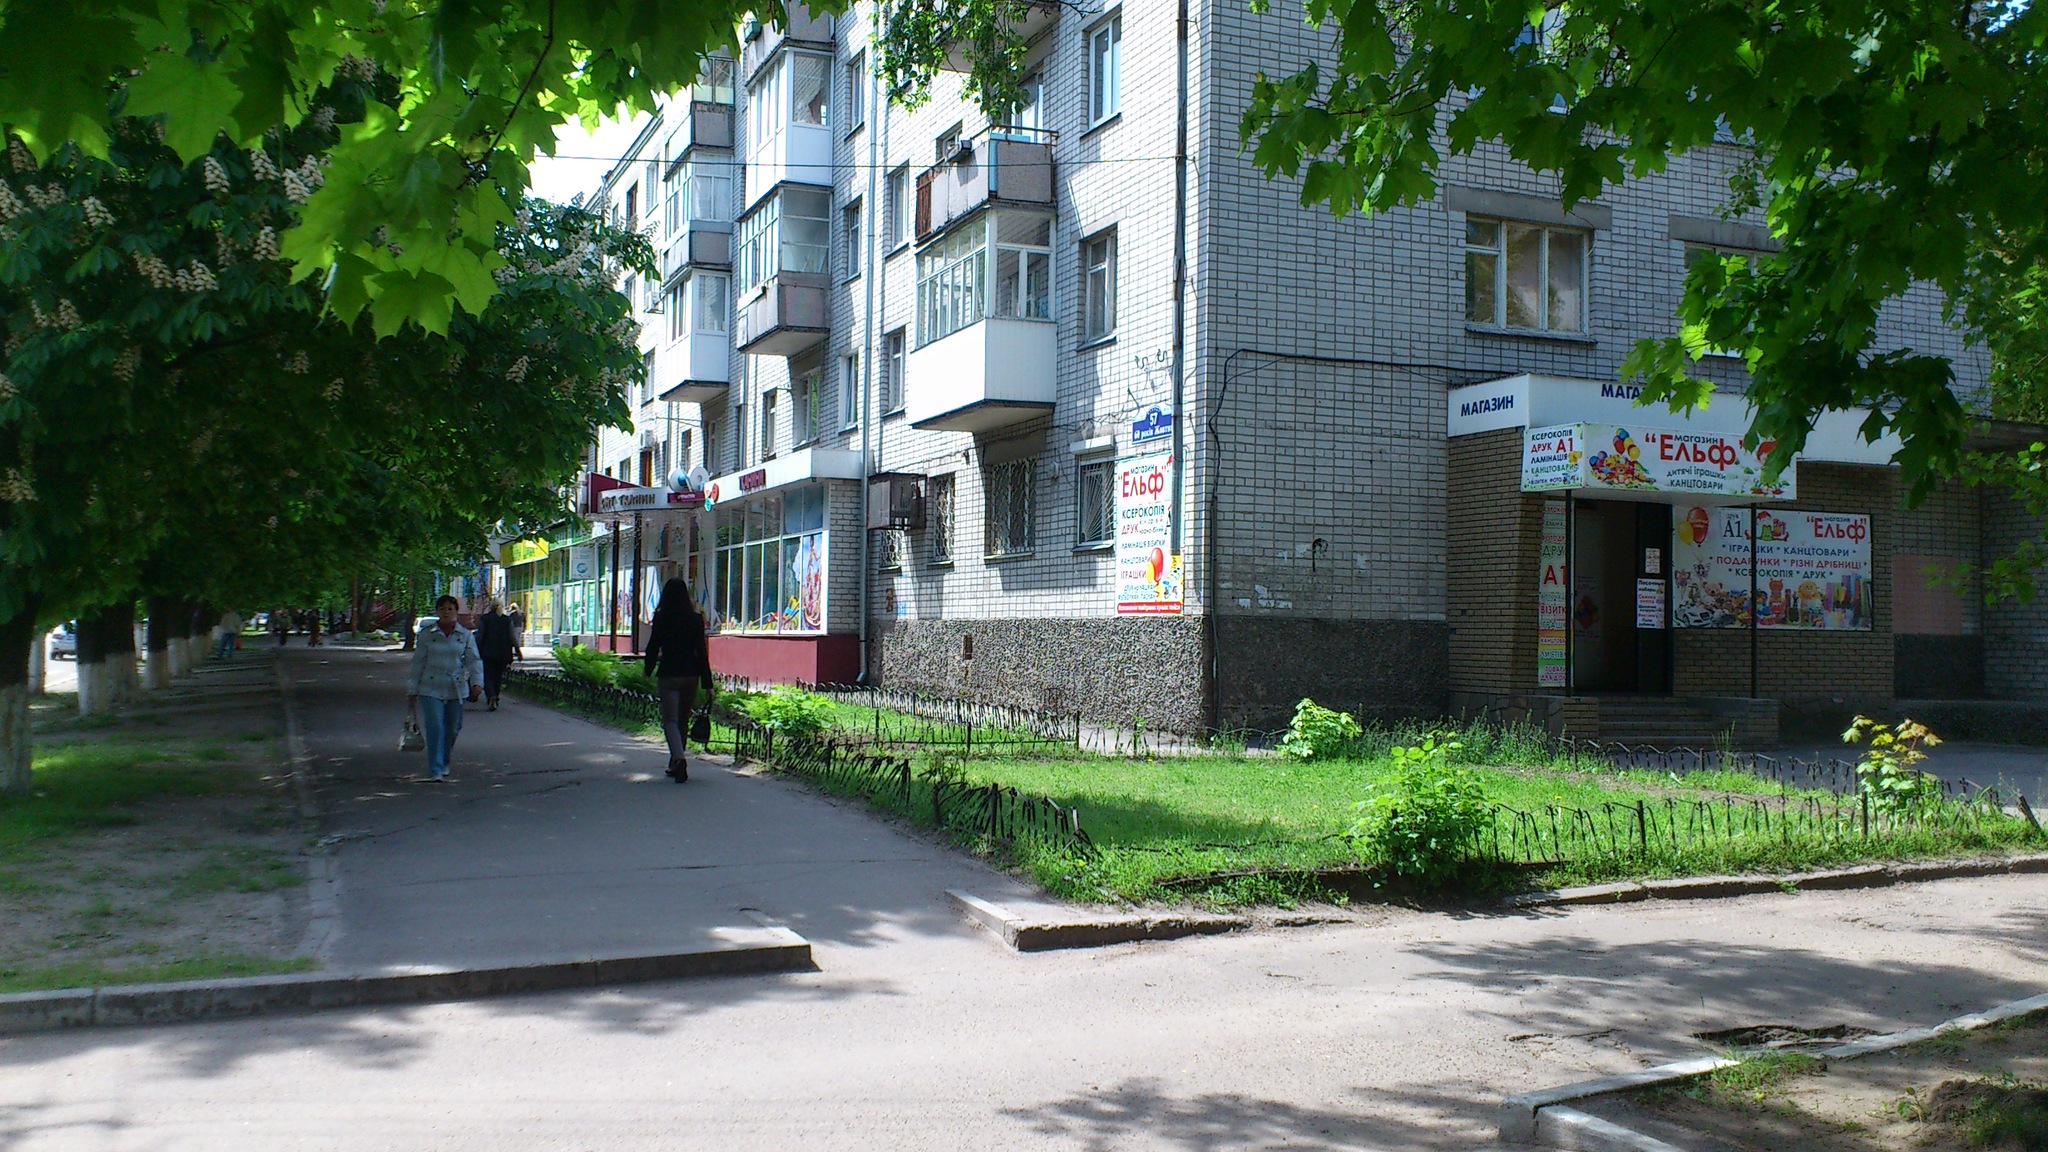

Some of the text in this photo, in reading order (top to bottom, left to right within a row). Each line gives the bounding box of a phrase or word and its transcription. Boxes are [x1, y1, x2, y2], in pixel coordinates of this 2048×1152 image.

[1601, 383, 1671, 402] МАГА
[1461, 395, 1514, 417] МАГАЗИН
[1149, 412, 1159, 426] 57
[1531, 429, 1573, 441] КСЕРОКОПІЯ
[1674, 434, 1718, 444] магазин
[1531, 437, 1573, 453] ДРУК А1
[1531, 453, 1568, 464] ЛАМІНАЦІЯ
[1531, 463, 1576, 475] КАНЦТОВАРИ
[1667, 466, 1726, 480] дитячі іграшки
[1669, 479, 1723, 490] КАНЦТОВАРИ
[1122, 504, 1165, 519] КСЕРОКОПІЯ
[1121, 523, 1139, 535] ДРУК
[1723, 520, 1743, 537] А1
[1542, 545, 1565, 556] ДРУ
[1784, 547, 1849, 556] КАНЦТОВАРИ
[1790, 559, 1813, 568] РІЗНІ
[1816, 560, 1861, 570] ДРІБНИЦІ
[1735, 568, 1826, 579] КСЕОКОПІЯ ДРУК
[1541, 605, 1566, 614] ВІЗИТК
[1540, 621, 1565, 629] ІГРАШ
